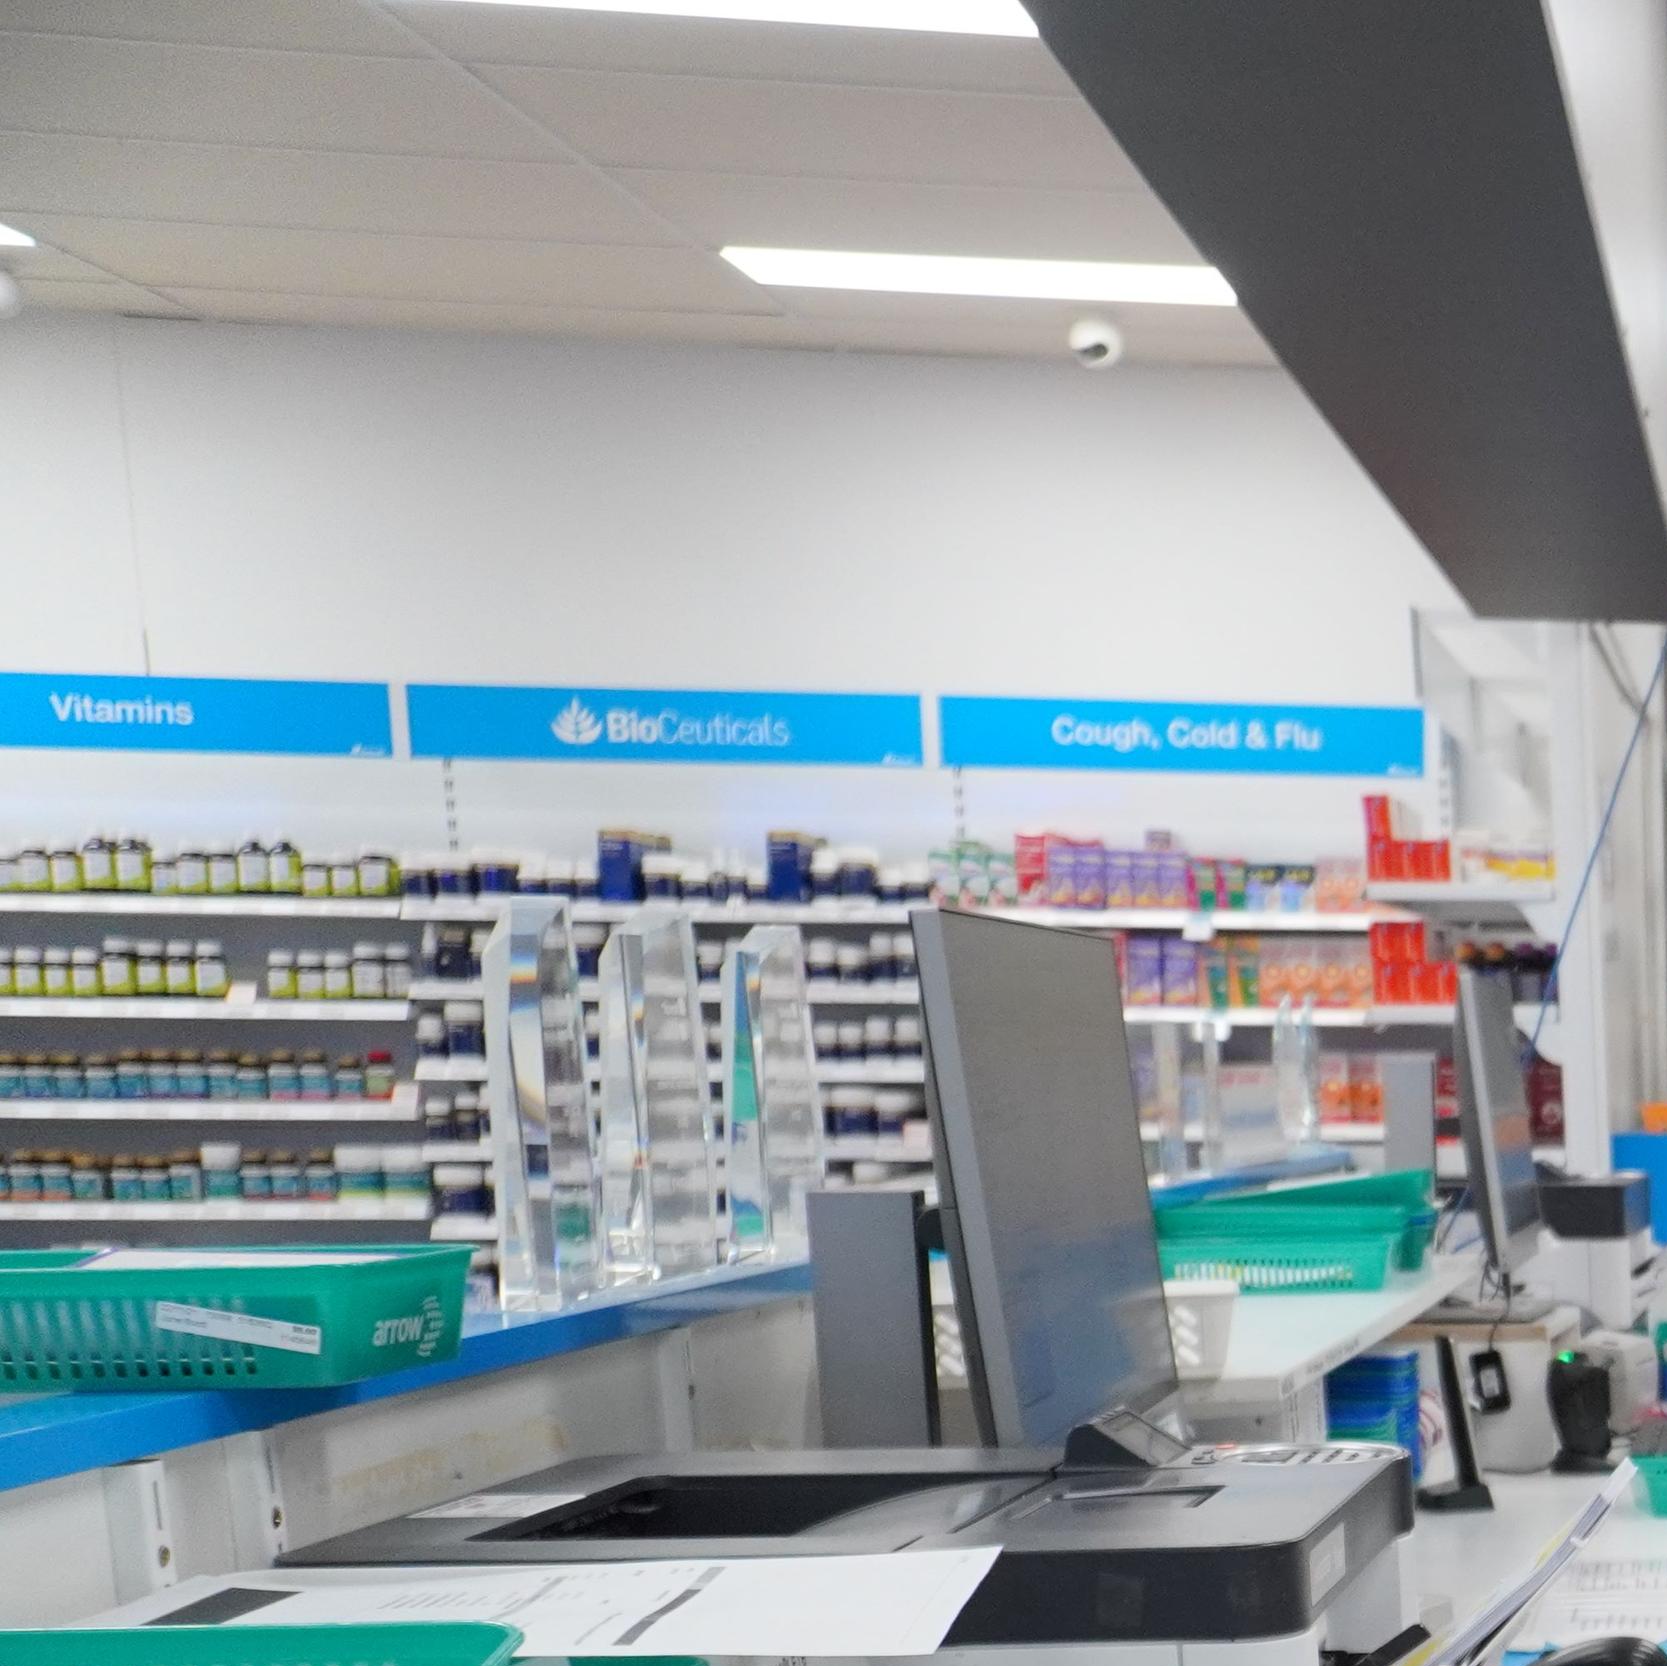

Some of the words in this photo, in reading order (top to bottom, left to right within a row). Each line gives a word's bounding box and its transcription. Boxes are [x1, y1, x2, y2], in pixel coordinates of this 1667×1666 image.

[51, 693, 193, 726] Vitamins
[608, 709, 790, 747] BioCeuticals
[1052, 716, 1160, 751] Cough,
[1167, 719, 1237, 749] Cold
[1245, 721, 1267, 749] &
[1274, 721, 1321, 751] Flu
